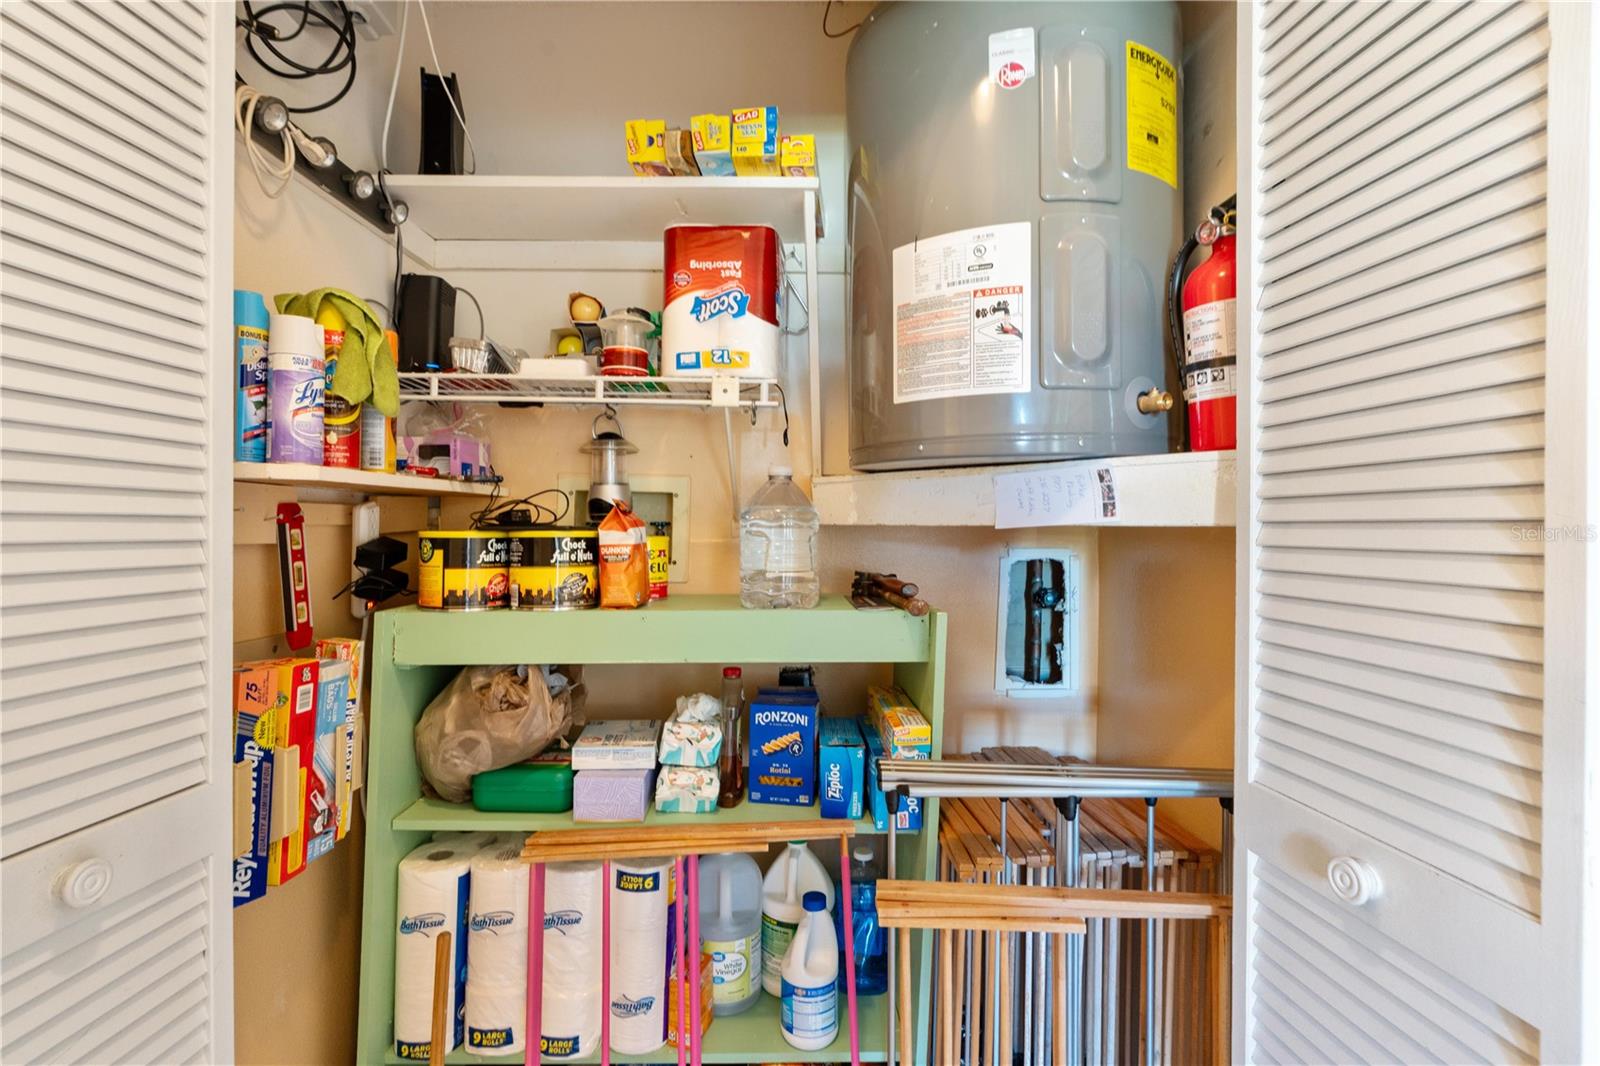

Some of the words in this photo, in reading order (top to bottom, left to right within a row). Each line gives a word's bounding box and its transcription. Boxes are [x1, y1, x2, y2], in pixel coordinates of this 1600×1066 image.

[735, 110, 759, 122] GLAD
[690, 259, 742, 271] Absorbing
[720, 269, 742, 278] Fast
[985, 286, 1020, 296] DANGER
[699, 290, 742, 321] Scott
[240, 330, 262, 340] BONUS
[711, 349, 731, 364] 12
[562, 537, 586, 551] Chock
[476, 550, 495, 564] full
[550, 549, 570, 564] full
[245, 682, 258, 702] 75
[755, 711, 808, 727] RONZONI
[827, 763, 844, 800] Ziploc
[715, 968, 742, 976] Vinegar
[724, 962, 742, 970] White
[473, 1032, 482, 1044] 9
[482, 1032, 507, 1040] LARGE
[482, 1038, 504, 1047] ROLLS
[549, 1039, 573, 1048] LARGE
[401, 1046, 409, 1057] 9
[549, 1047, 570, 1055] ROLLS
